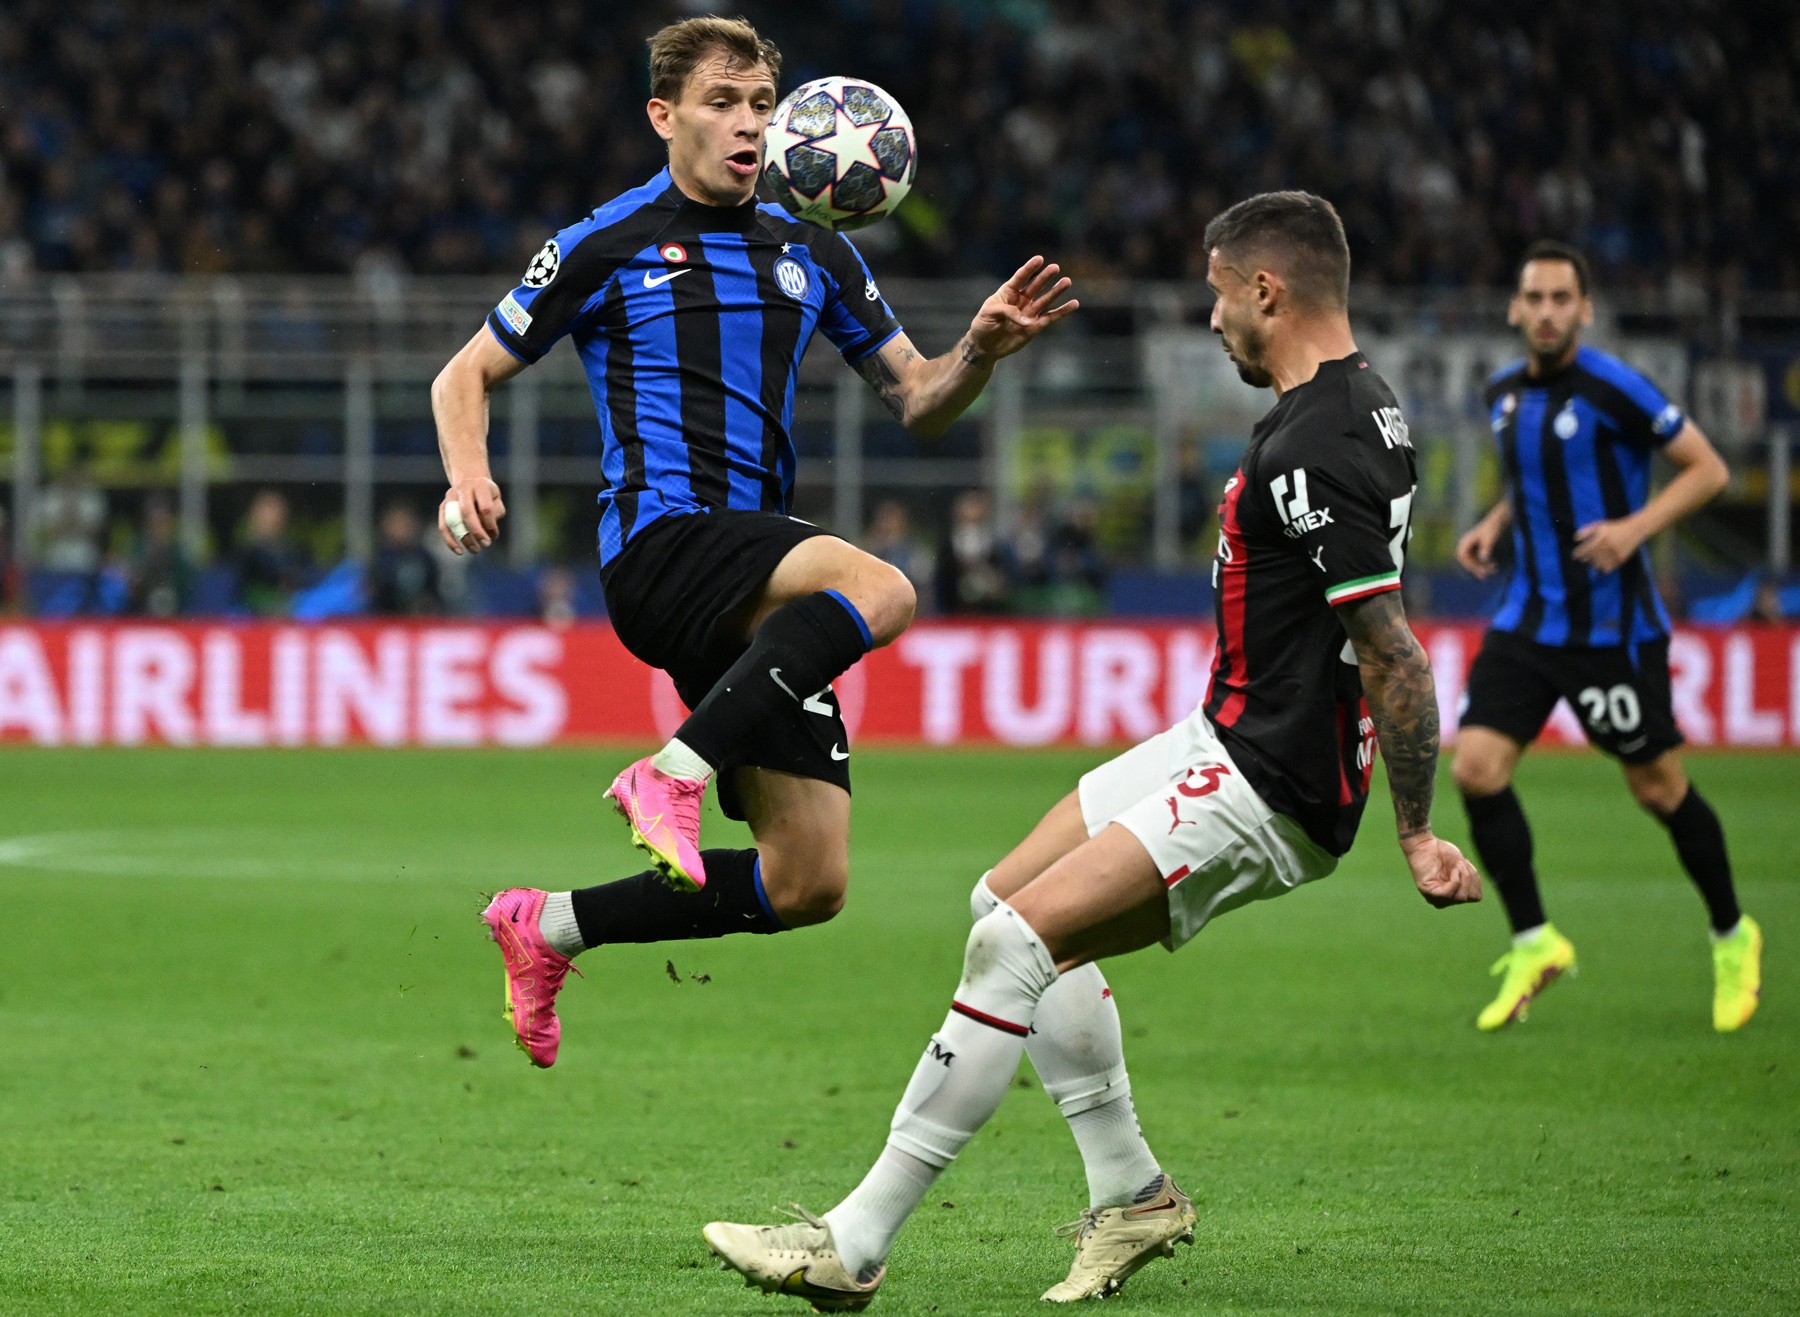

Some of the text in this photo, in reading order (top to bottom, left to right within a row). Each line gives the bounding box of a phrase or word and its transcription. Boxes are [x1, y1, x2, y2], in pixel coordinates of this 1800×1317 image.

[1283, 507, 1335, 539] MEX
[0, 628, 567, 747] AIRLINES
[1579, 684, 1641, 733] 20
